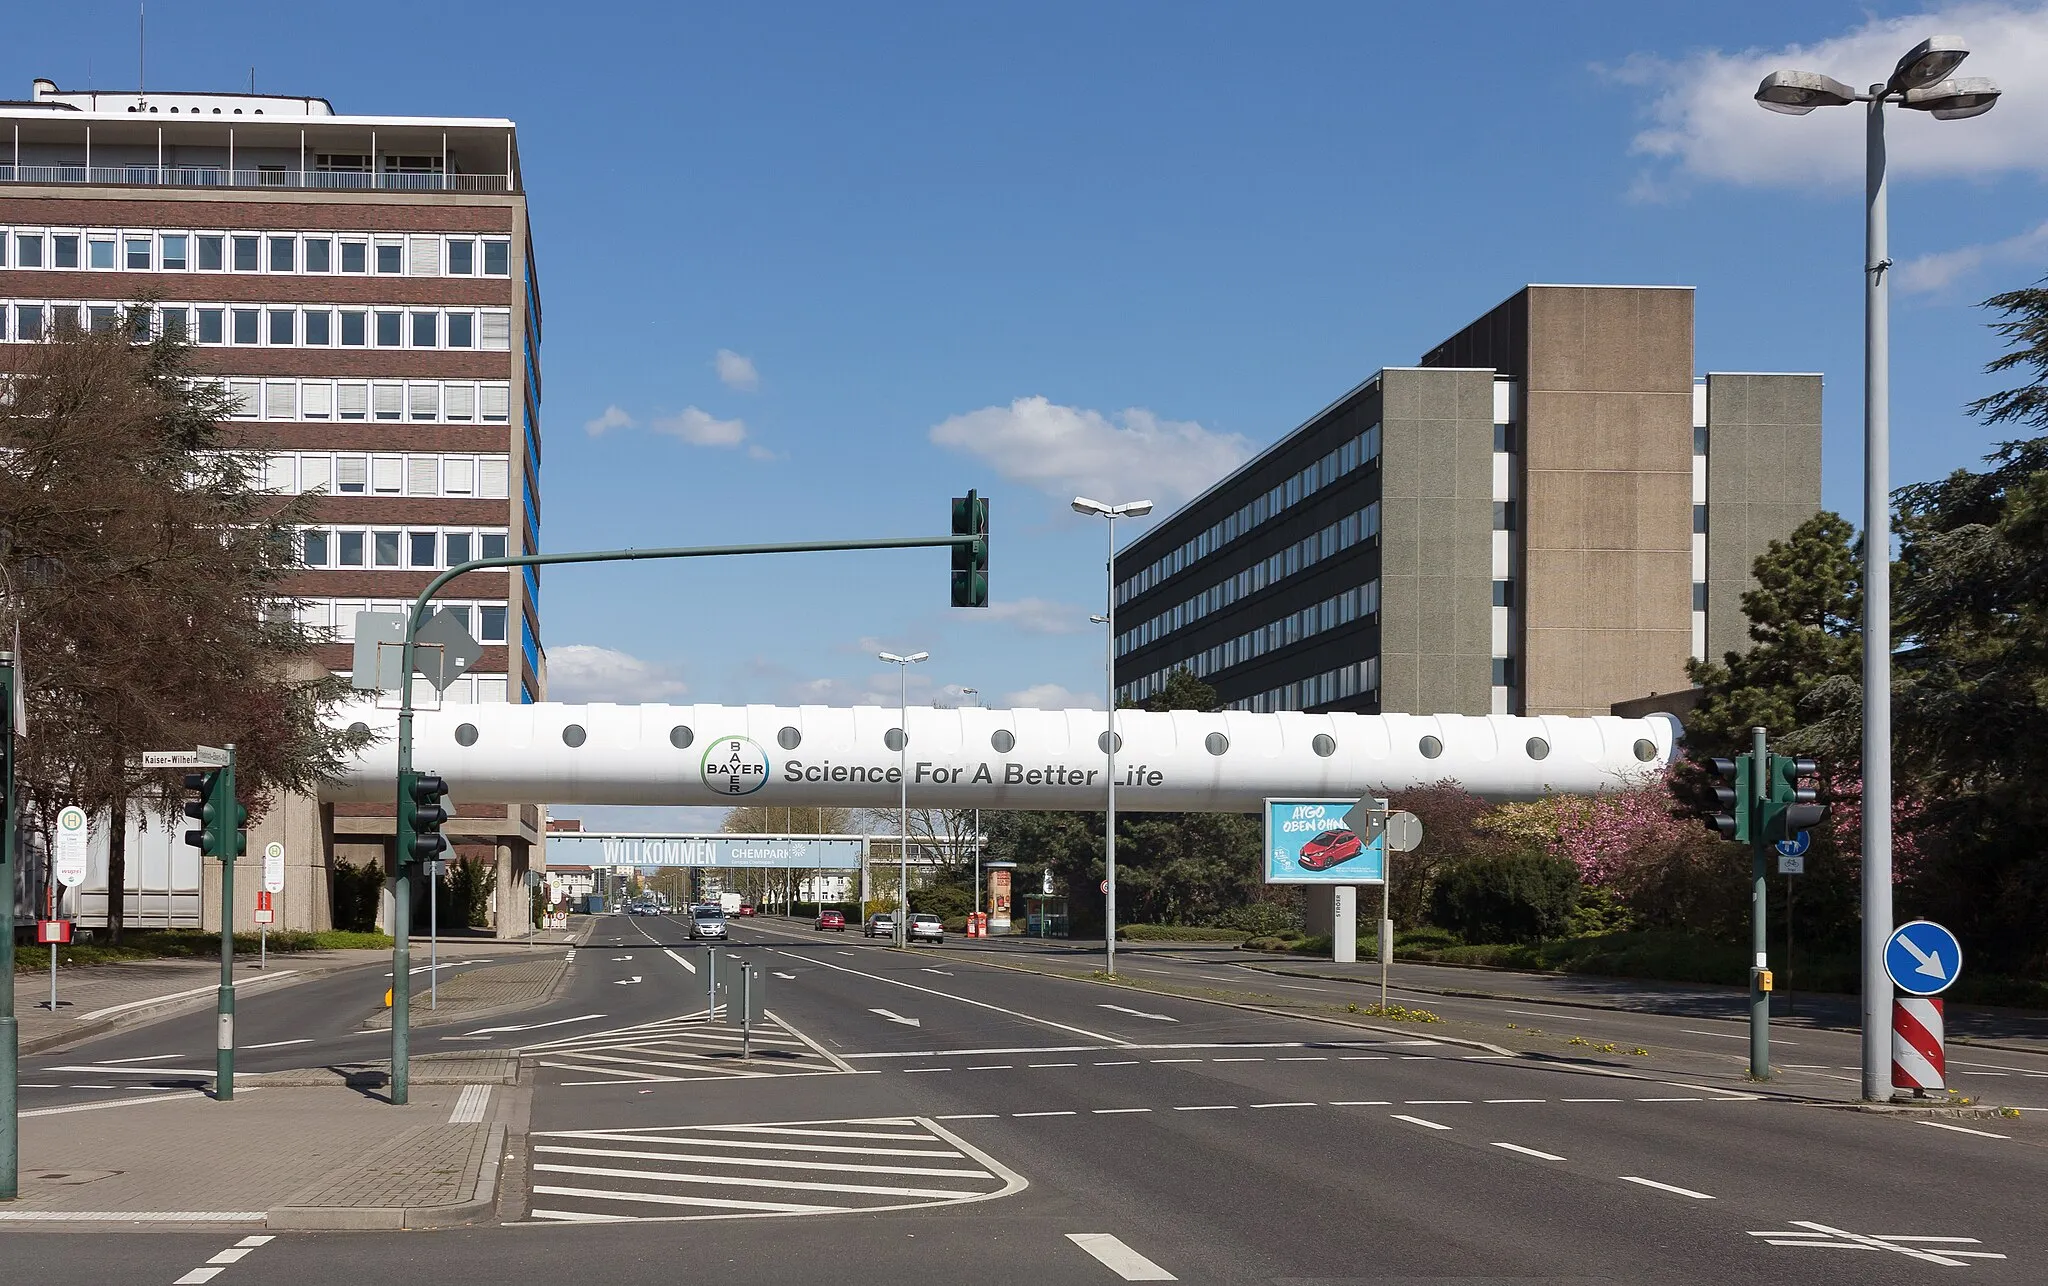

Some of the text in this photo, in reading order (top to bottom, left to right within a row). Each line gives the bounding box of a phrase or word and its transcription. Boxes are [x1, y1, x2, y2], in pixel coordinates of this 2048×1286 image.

[707, 764, 763, 774] BAYER
[729, 741, 741, 793] BAYER
[783, 760, 901, 783] Science
[915, 762, 963, 783] For
[971, 763, 992, 784] A
[1004, 763, 1098, 786] Better
[1292, 805, 1325, 820] AYGO
[1283, 820, 1316, 833] OBEN
[603, 842, 717, 865] WILLKOMMEN
[731, 848, 792, 859] CHEMPARK
